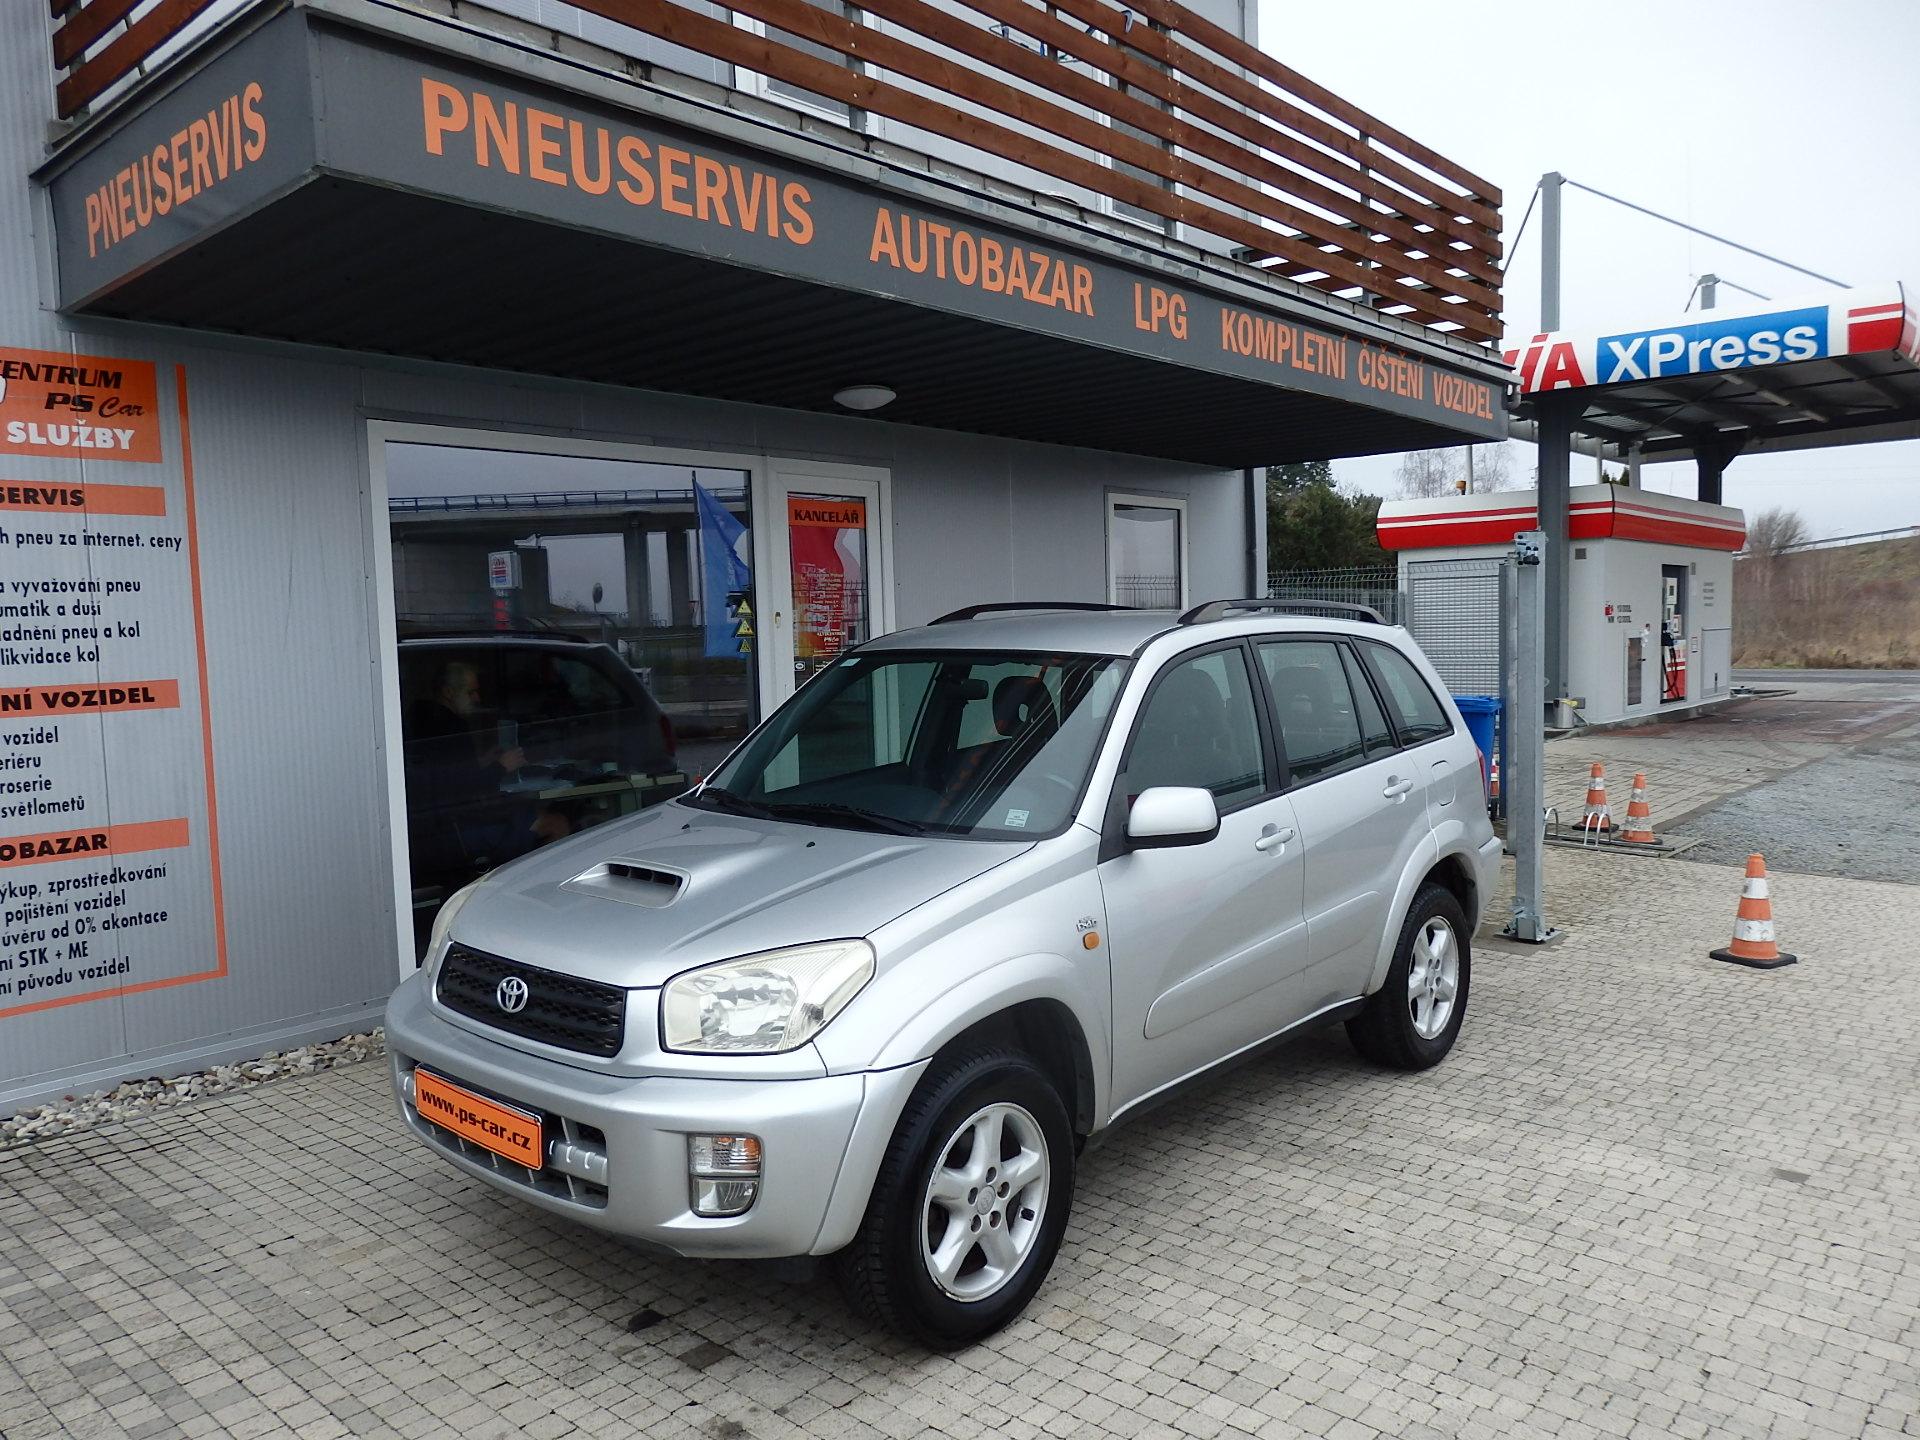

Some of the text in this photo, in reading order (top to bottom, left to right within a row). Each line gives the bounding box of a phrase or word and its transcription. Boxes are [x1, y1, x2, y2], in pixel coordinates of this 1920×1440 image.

[85, 82, 266, 258] PNEUSERVIS
[422, 77, 1494, 420] PNEUSERVIS AUTOBAZAR LPG KOMPLETNÍ ČIŠTĚNÍ VOZIDEL
[1607, 325, 1818, 383] XPress
[0, 360, 122, 389] ENTRUM
[44, 392, 145, 418] PS Car
[7, 418, 135, 450] SLUŽBY
[794, 508, 860, 523] KANCELÁŘ
[16, 532, 53, 548] pneu
[59, 533, 77, 546] za
[83, 529, 144, 547] internet.
[150, 536, 182, 552] ceny
[12, 578, 100, 597] vyvažování
[106, 580, 141, 596] pneu
[57, 604, 65, 616] a
[62, 626, 98, 643] pneu
[103, 627, 112, 638] a
[118, 621, 140, 638] kol
[1, 645, 100, 666] likvidace kol
[1, 687, 155, 711] NÍ VOZIDEL
[3, 726, 59, 746] vozidel
[0, 774, 52, 794] roserie
[1, 796, 85, 818] světlometů
[0, 833, 108, 861] OBAZAR
[49, 863, 167, 896] zprostředkování
[5, 889, 126, 927] pojištění vozidel
[2, 910, 168, 947] úvěru od 0% akontace
[19, 948, 49, 968] STK
[55, 949, 62, 960] +
[68, 941, 89, 960] ME
[18, 967, 73, 995] původu
[78, 956, 130, 980] vozidel
[421, 1088, 531, 1150] www.ps-car.cz
